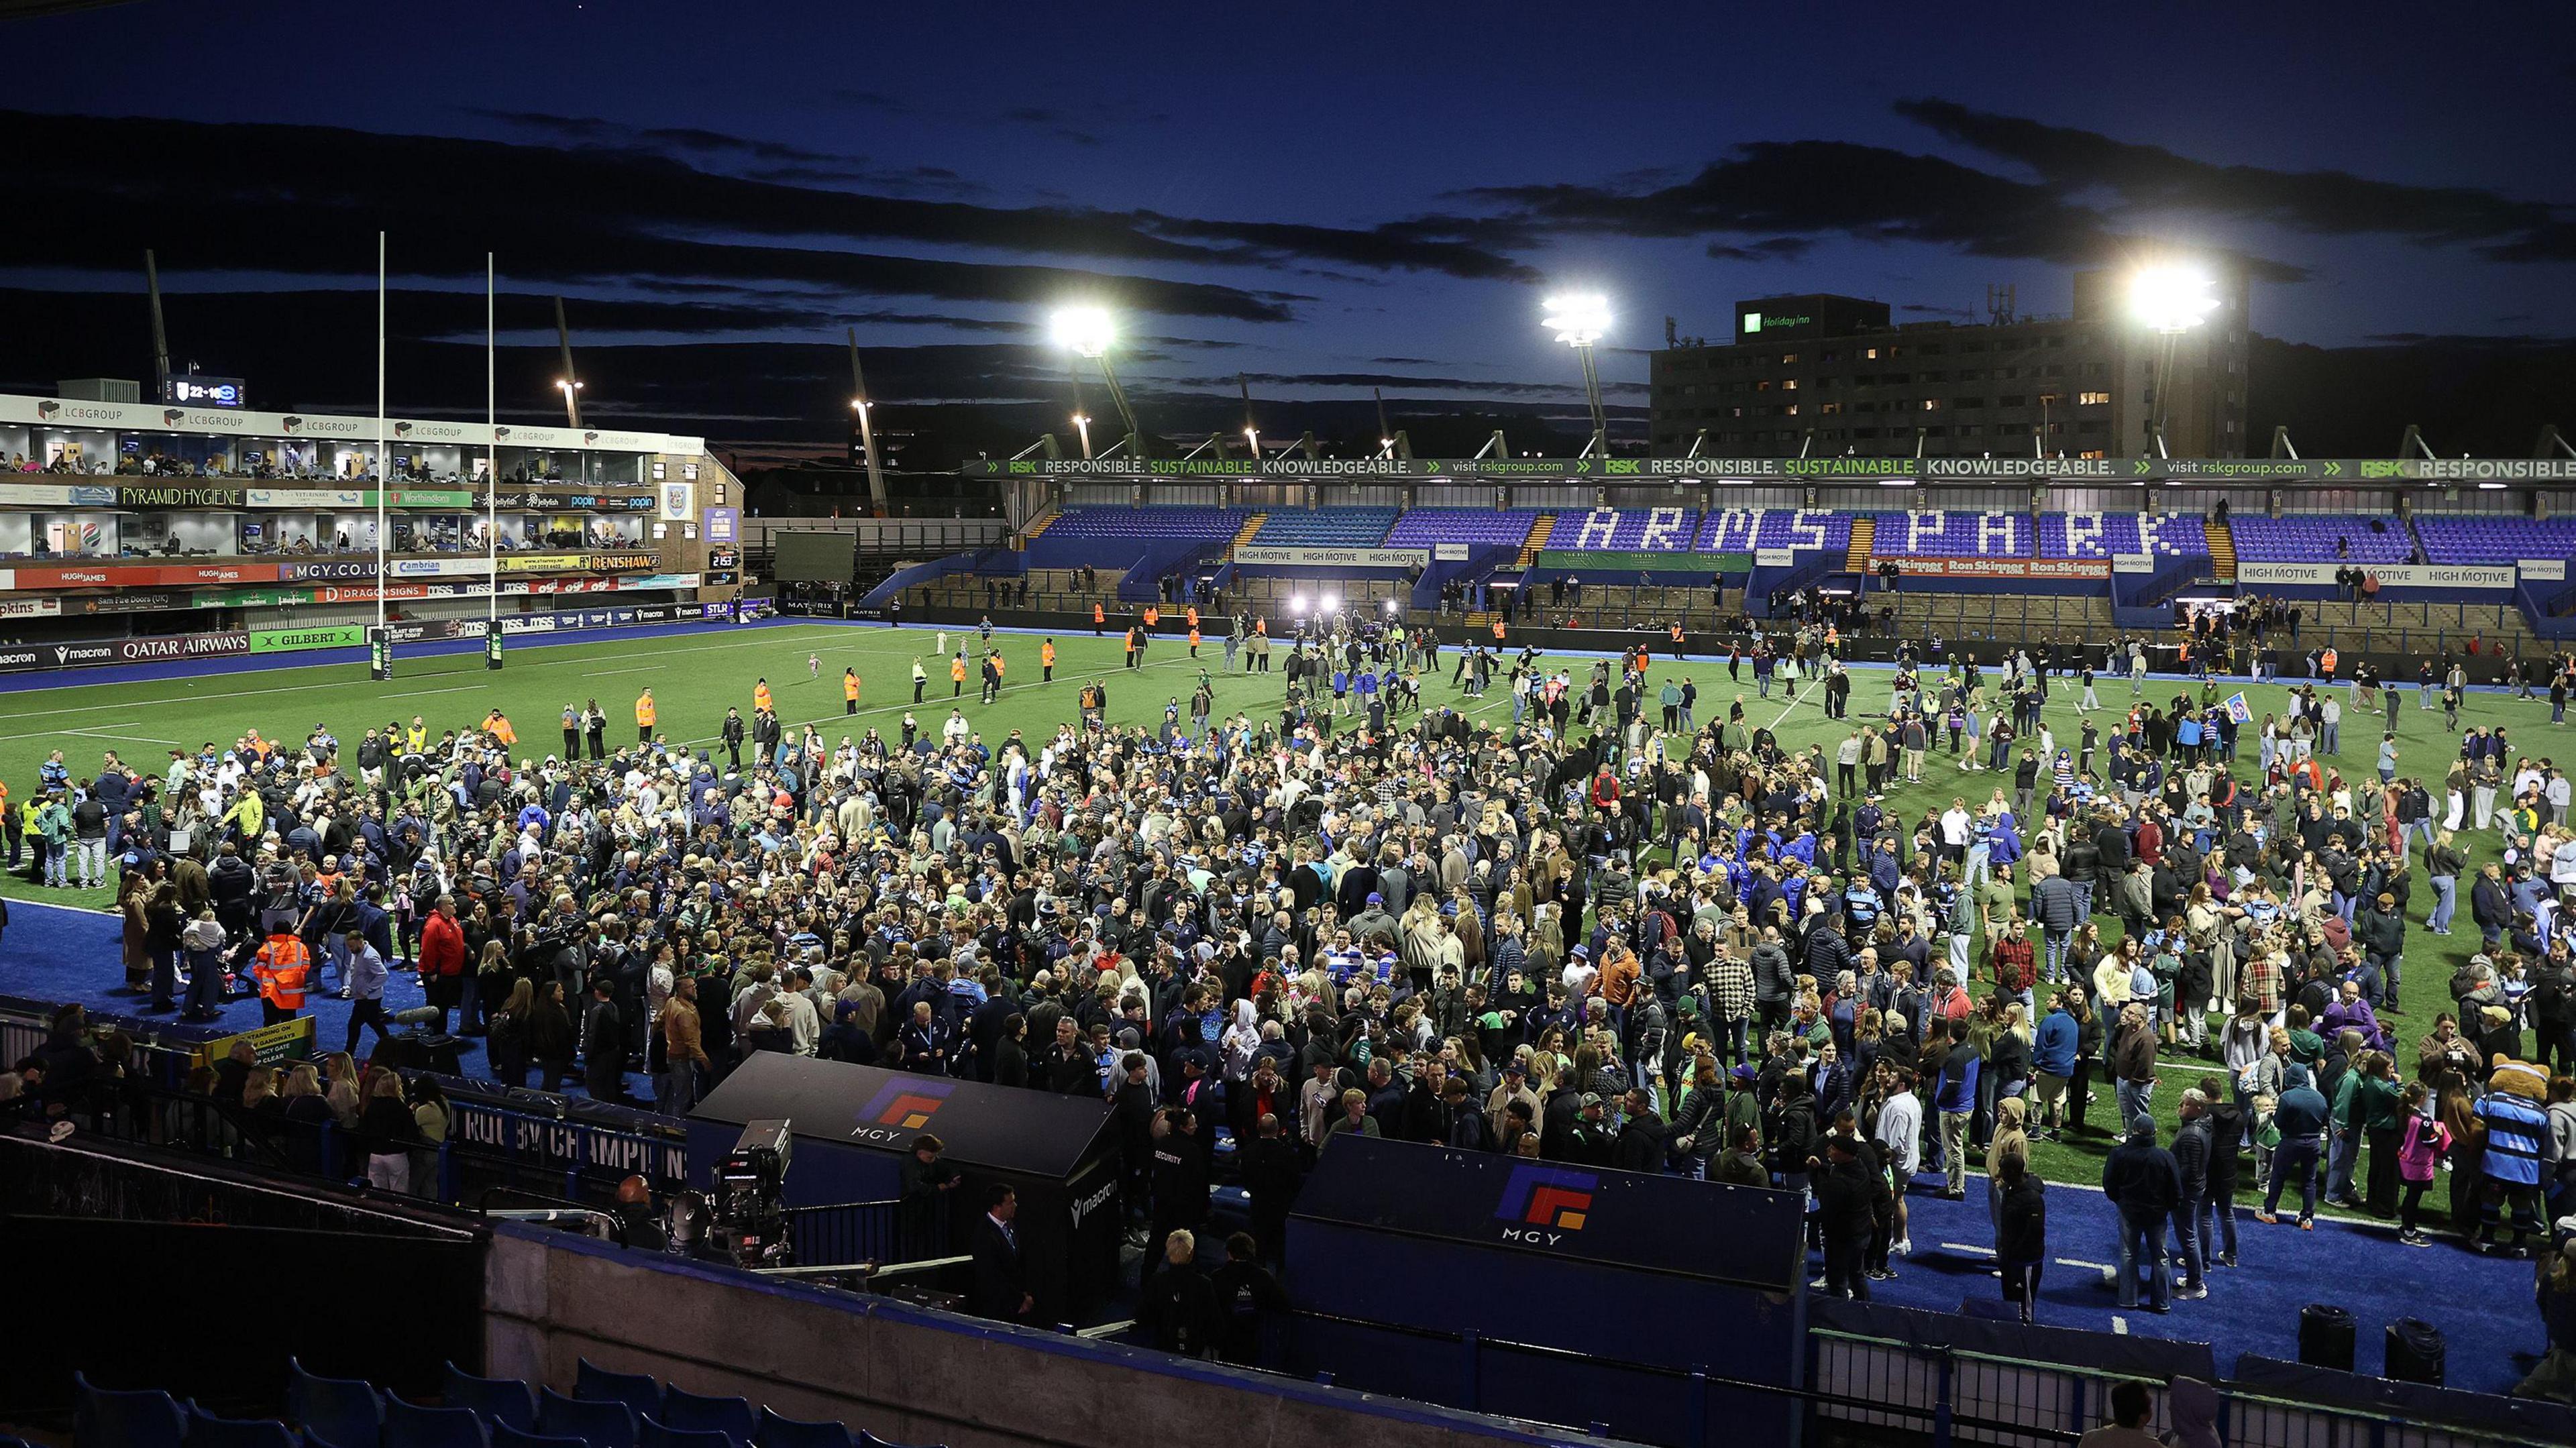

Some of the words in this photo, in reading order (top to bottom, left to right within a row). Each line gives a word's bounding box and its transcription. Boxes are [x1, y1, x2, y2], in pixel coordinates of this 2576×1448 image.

[1764, 316, 1795, 327] Holiday
[1796, 315, 1810, 324] Inn
[65, 407, 122, 420] LCBGROUP
[189, 414, 244, 427] LCBGROUP
[307, 421, 358, 432] LCBGROUP
[416, 427, 462, 437] LCBGROUP
[513, 431, 555, 441] LCBGROUP
[1010, 461, 1037, 474] RSK
[1045, 460, 1145, 474] RESPONSIBLE.
[1150, 460, 1256, 474] SUSTAINABLE.
[1262, 460, 1411, 474] KNOWLEDGEABLE.
[1452, 460, 1477, 471] visit
[1481, 459, 1563, 474] rskgroup.com
[1605, 459, 1641, 474] RSK
[1651, 459, 1778, 474] RESPONSIBLE.
[1784, 459, 1919, 475] SUSTAINABLE.
[1927, 459, 2116, 476] KNOWLEDGEABLE.
[2167, 460, 2198, 473] visit
[2202, 460, 2307, 477] rskgroup.com
[2360, 461, 2406, 477] RSK
[123, 487, 181, 505] PYRAMID
[182, 488, 242, 506] HYGIENE
[403, 492, 450, 504] Worthington's
[494, 496, 517, 507] Jellyfish
[572, 495, 596, 508] popin
[629, 496, 652, 509] popin
[537, 498, 559, 508] Jellyfish
[592, 555, 652, 569] RENISHAW
[1238, 551, 1259, 560] HIGH
[1260, 551, 1291, 561] MOTIVE
[1303, 551, 1324, 561] HIGH
[1325, 552, 1357, 561] MOTIVE
[1369, 553, 1391, 562] HIGH
[1392, 553, 1425, 563] MOTIVE
[400, 561, 440, 572] Cambrian
[1896, 559, 1943, 570] Skinner
[1948, 560, 1974, 570] Ron
[1975, 560, 2025, 572] Skinner
[2030, 561, 2056, 571] Ron
[2057, 561, 2108, 573] Skinner
[2244, 568, 2273, 578] HIGH
[2274, 569, 2318, 579] MOTIVE
[2428, 571, 2459, 581] HIGH
[2461, 571, 2508, 582] MOTIVE
[428, 585, 454, 596] mss
[466, 583, 492, 594] mss
[504, 581, 529, 593] mss
[538, 578, 559, 593] ogi
[565, 577, 585, 592] ogi
[590, 577, 610, 592] ogi
[390, 587, 419, 596] SIGNS
[152, 594, 168, 603] (UK)
[682, 608, 702, 616] macron
[707, 603, 728, 614] STLR
[530, 616, 555, 628] mss
[281, 632, 336, 645] GILBERT
[70, 647, 111, 660] macron
[123, 641, 180, 659] QATAR
[182, 636, 248, 654] AIRWAYS
[0, 652, 36, 665] acron
[1851, 902, 1867, 910] RSK
[259, 1032, 296, 1048] GANGWAYS
[274, 1042, 290, 1052] GATE
[262, 1053, 284, 1064] CLEAR
[852, 1127, 901, 1142] MGY
[1155, 1150, 1182, 1165] SECURITY
[1083, 1178, 1118, 1217] macron
[1502, 1227, 1561, 1246] MGY
